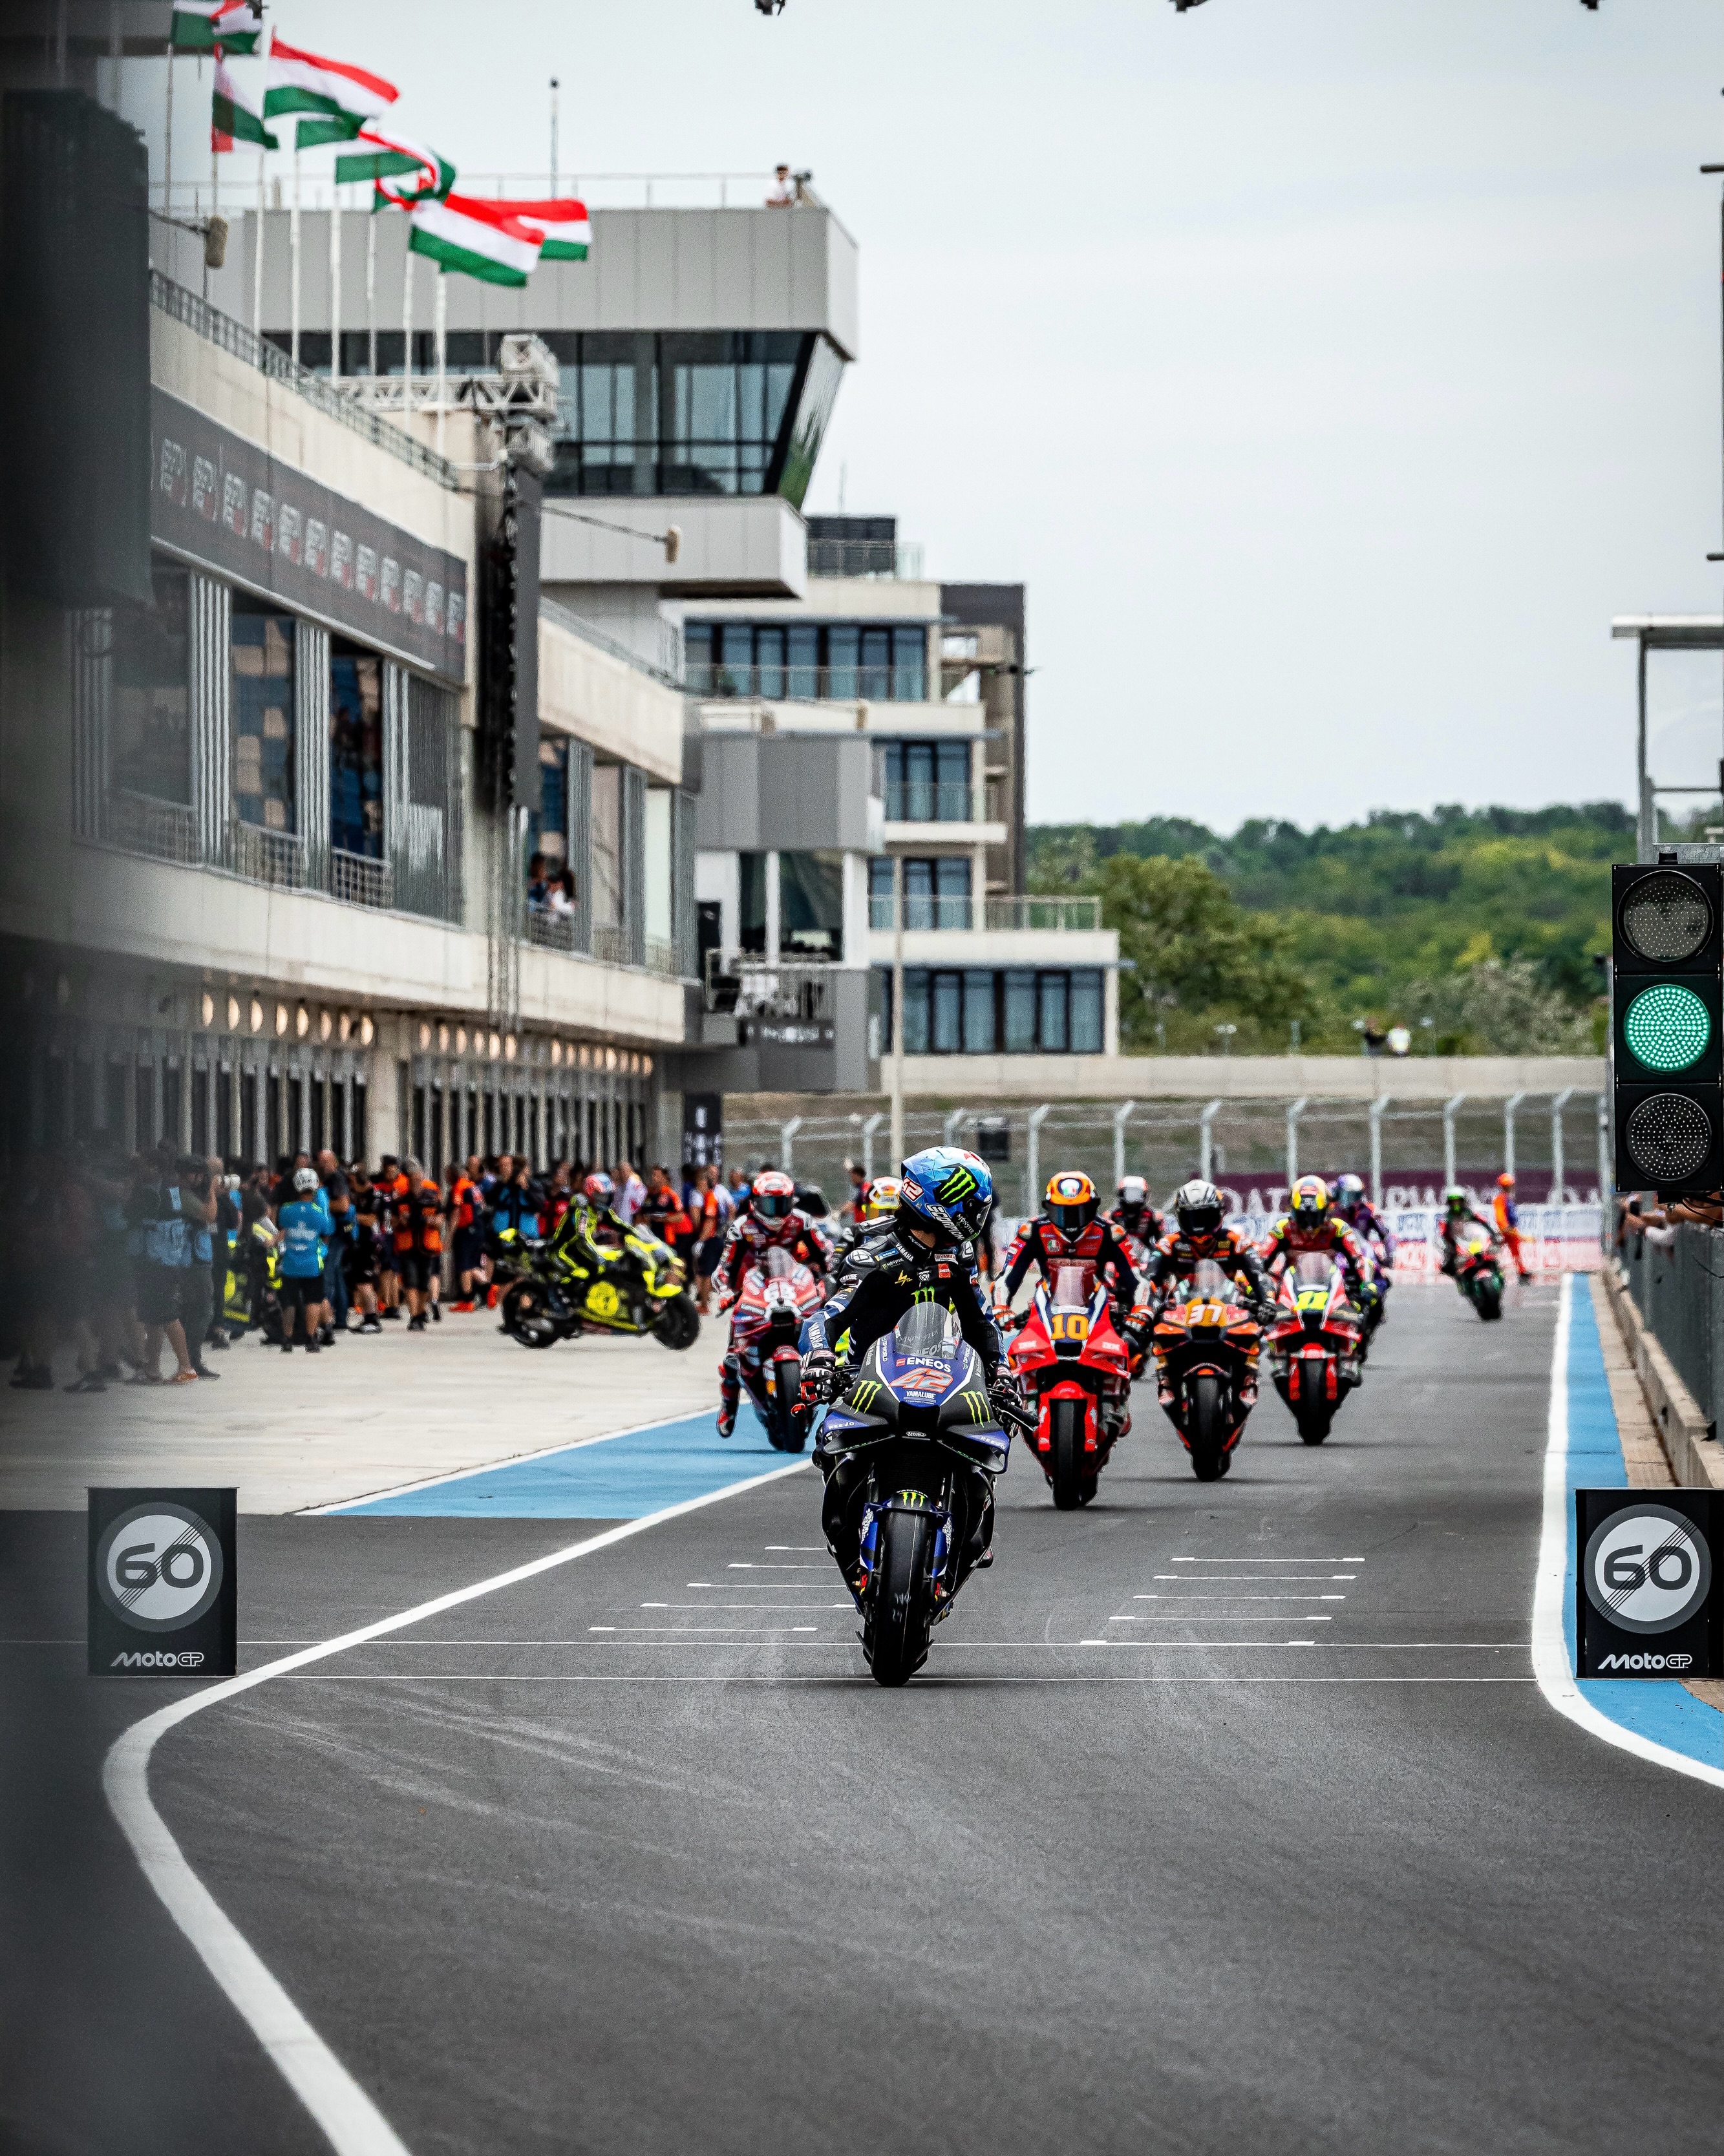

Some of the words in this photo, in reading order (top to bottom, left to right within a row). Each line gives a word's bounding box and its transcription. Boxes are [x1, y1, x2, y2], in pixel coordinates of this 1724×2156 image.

[926, 1204, 966, 1241] SCORPION
[895, 1242, 914, 1262] YAMAHA
[1189, 1304, 1224, 1325] 37
[1050, 1313, 1090, 1340] 10
[906, 1357, 952, 1373] ENEOS
[888, 1367, 953, 1393] 42
[906, 1390, 937, 1400] YAMALUBE
[116, 1542, 204, 1589] 60
[1603, 1544, 1693, 1591] 60
[111, 1651, 204, 1667] MotoGP
[1597, 1653, 1693, 1669] MotoGP
